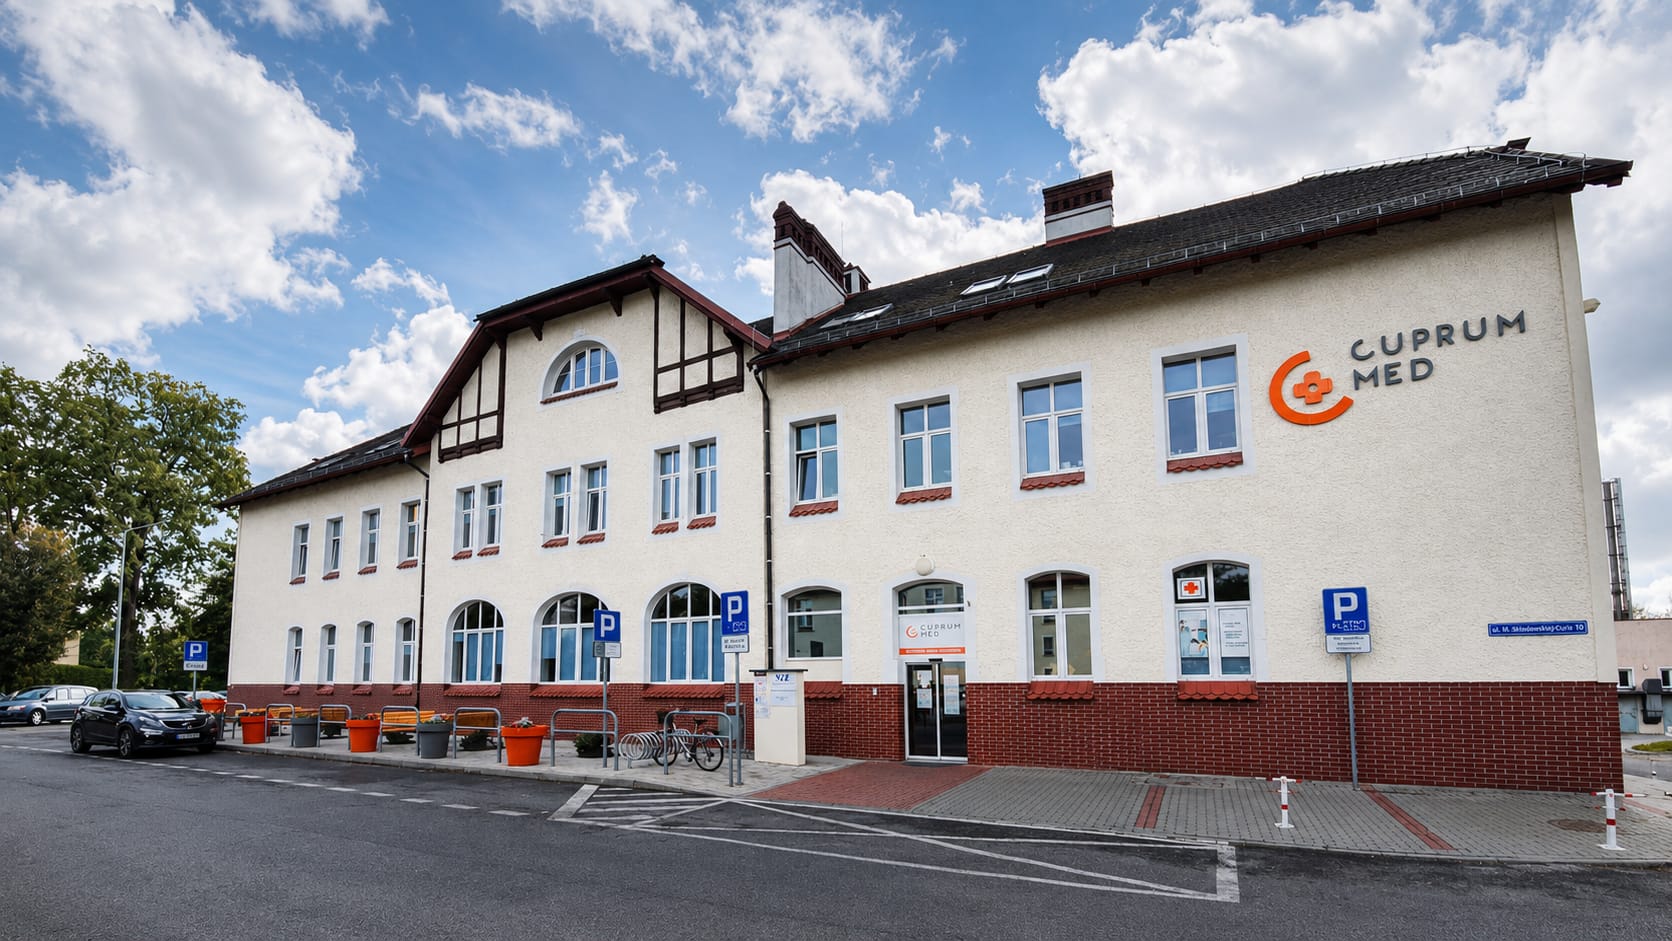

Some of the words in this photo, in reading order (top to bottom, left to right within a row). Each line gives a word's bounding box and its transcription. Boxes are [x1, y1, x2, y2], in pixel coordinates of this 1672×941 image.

[1351, 310, 1526, 361] CUPRUM
[1353, 357, 1434, 390] MED
[727, 595, 743, 622] P
[1333, 592, 1359, 621] P
[600, 614, 615, 638] P
[190, 643, 203, 657] P
